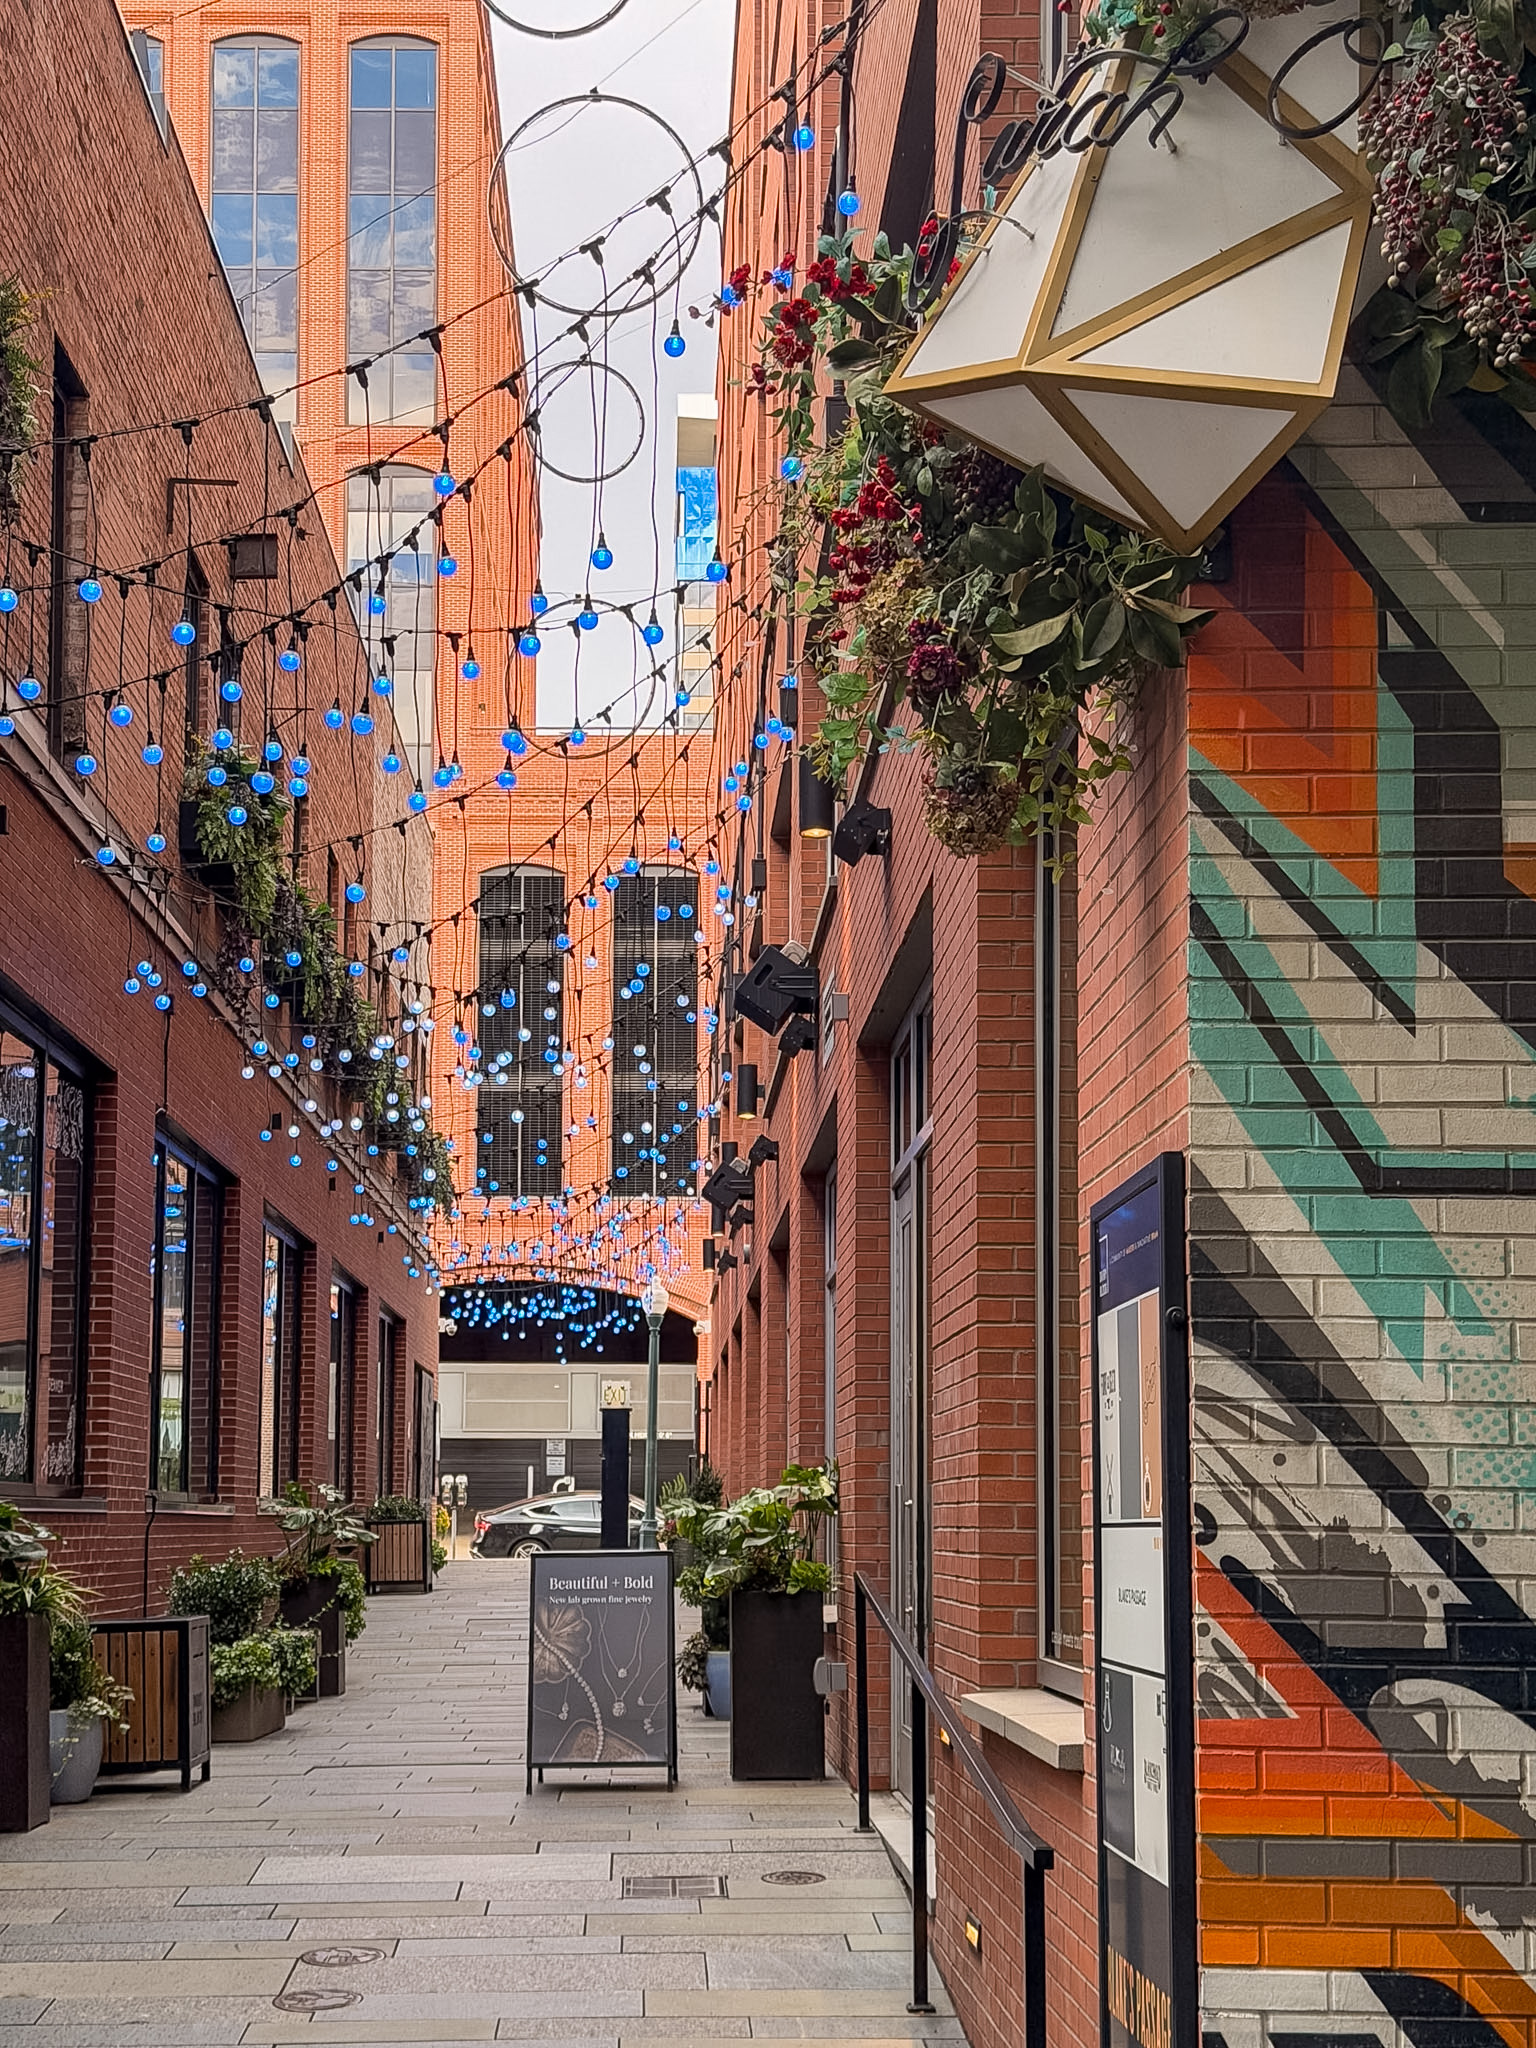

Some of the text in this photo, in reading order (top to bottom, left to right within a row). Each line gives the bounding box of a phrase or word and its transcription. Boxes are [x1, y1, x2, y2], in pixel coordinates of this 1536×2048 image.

[603, 1389, 627, 1402] EXIT
[549, 1575, 608, 1590] Beautiful
[624, 1575, 653, 1589] Bold
[549, 1594, 652, 1606] New lab grown fine jewelry
